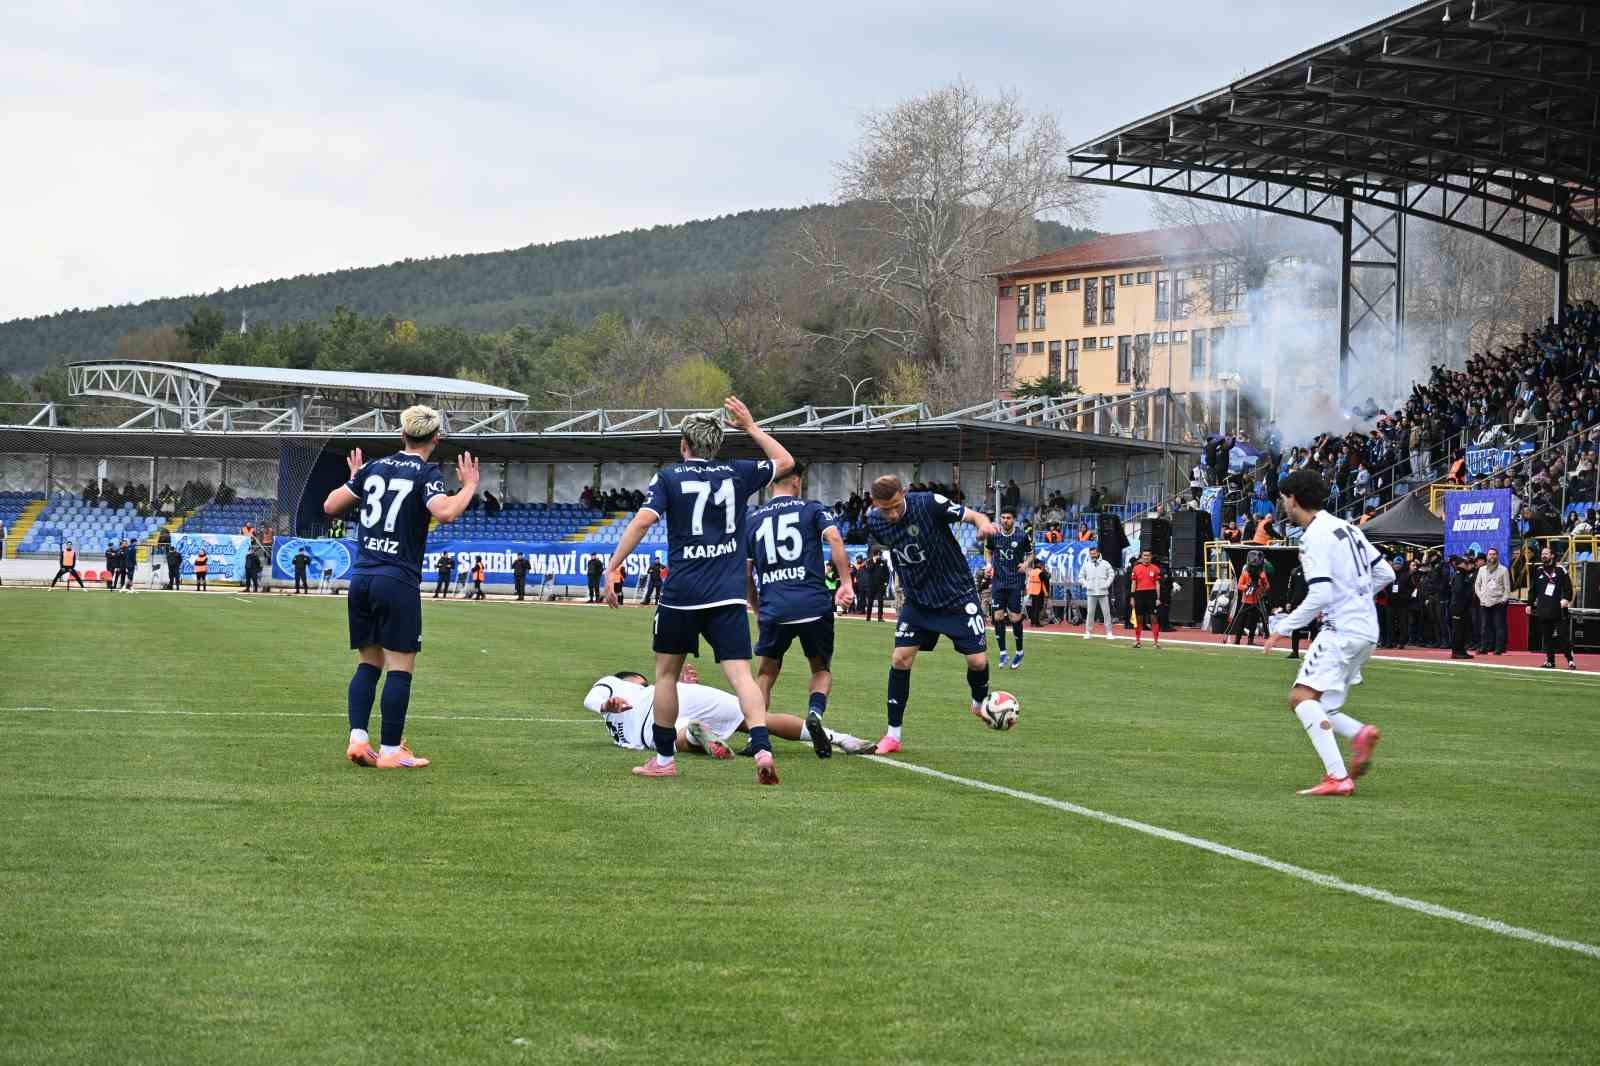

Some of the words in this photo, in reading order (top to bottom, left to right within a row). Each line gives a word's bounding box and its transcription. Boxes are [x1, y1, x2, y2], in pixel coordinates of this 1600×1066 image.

[360, 474, 414, 533] 37
[680, 478, 736, 536] 71
[1458, 501, 1495, 516] ŞAMPİYON
[756, 511, 803, 565] 15
[529, 550, 576, 575] MAVİ
[892, 543, 926, 567] NG
[999, 549, 1014, 561] NG
[762, 566, 806, 585] AKKUŞ
[967, 614, 985, 636] 10
